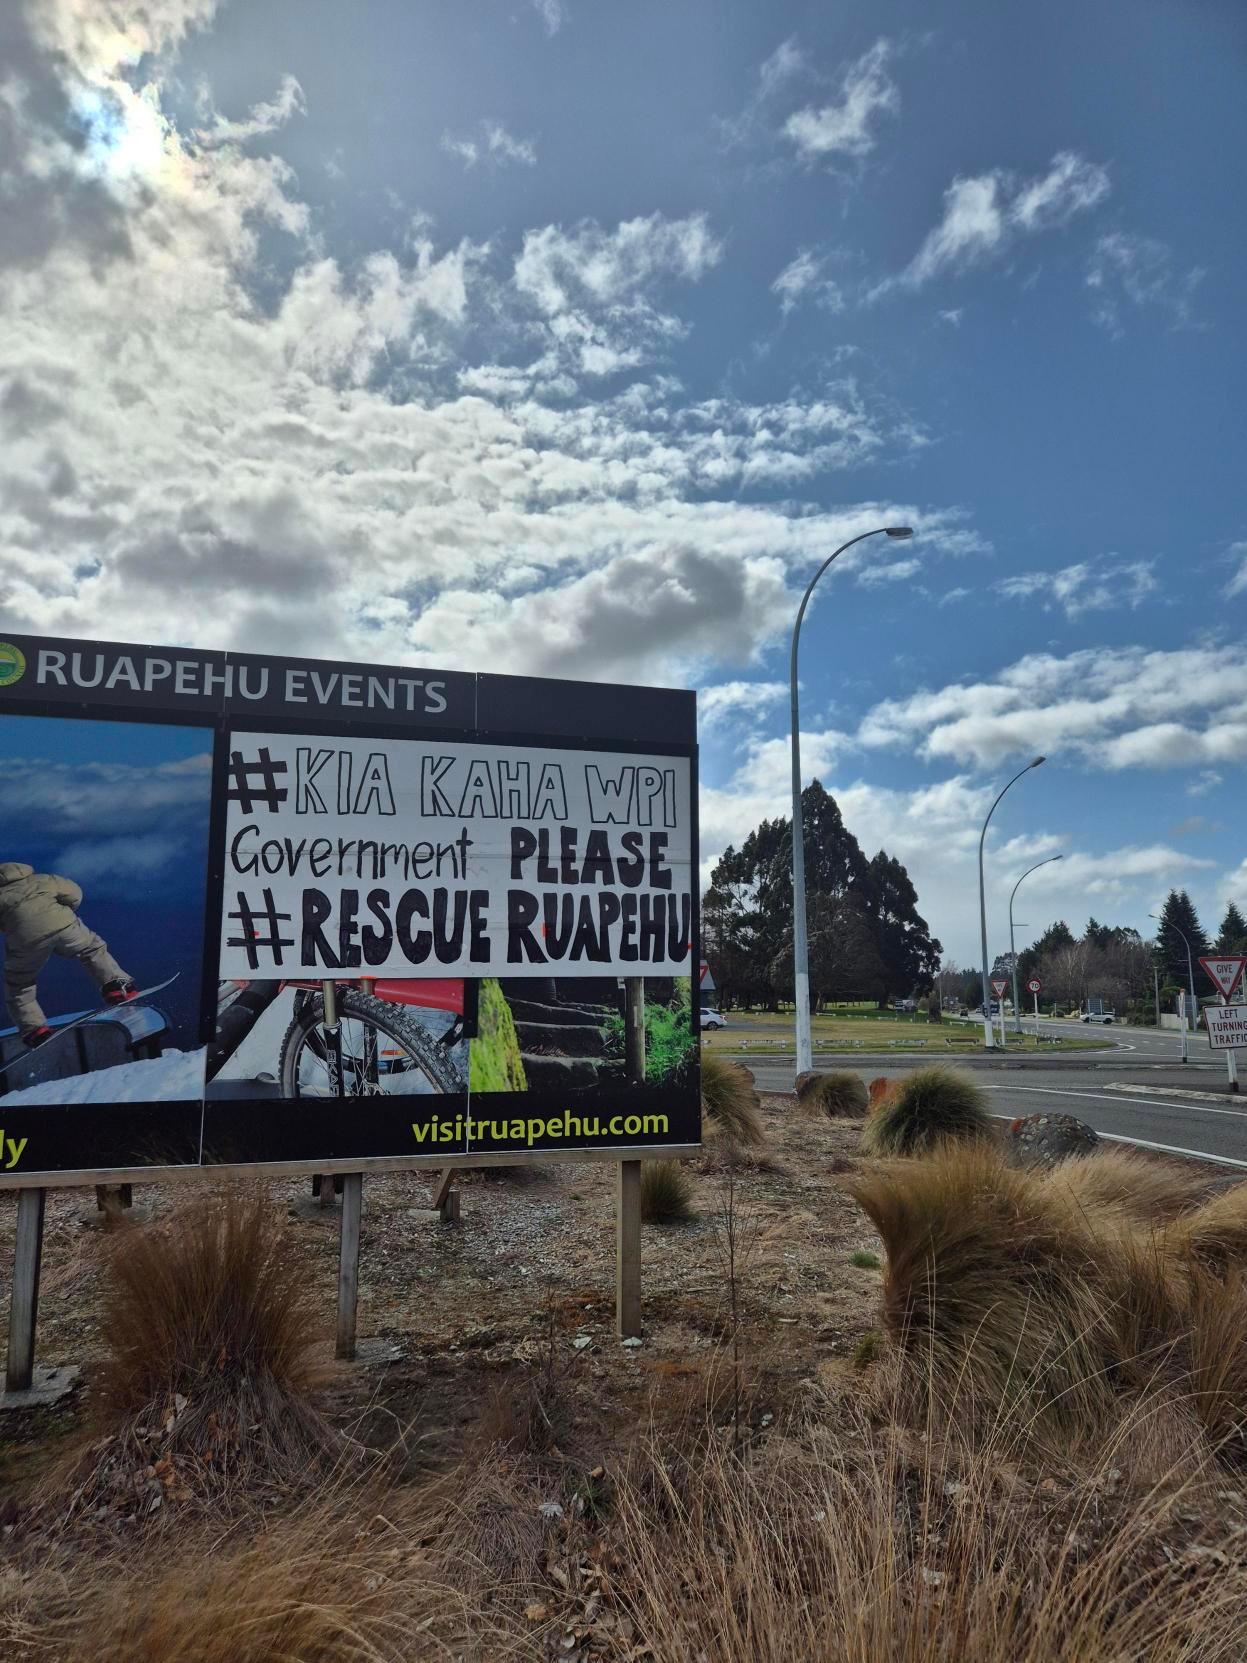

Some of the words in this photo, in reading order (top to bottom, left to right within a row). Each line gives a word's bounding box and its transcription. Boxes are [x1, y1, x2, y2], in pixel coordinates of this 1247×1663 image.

[36, 649, 269, 700] RUAPEHU
[285, 670, 448, 714] EVENTS
[227, 747, 396, 815] #KIA
[420, 755, 568, 821] KAHA
[585, 764, 677, 828] WPI
[230, 824, 474, 881] Government
[510, 825, 672, 890] PLEASE
[226, 887, 491, 970] #RESCUE
[507, 889, 692, 964] RUAPEHU
[1217, 965, 1232, 974] GIVE
[1219, 1009, 1238, 1019] LEFT
[411, 1109, 669, 1146] visitruapehu.com
